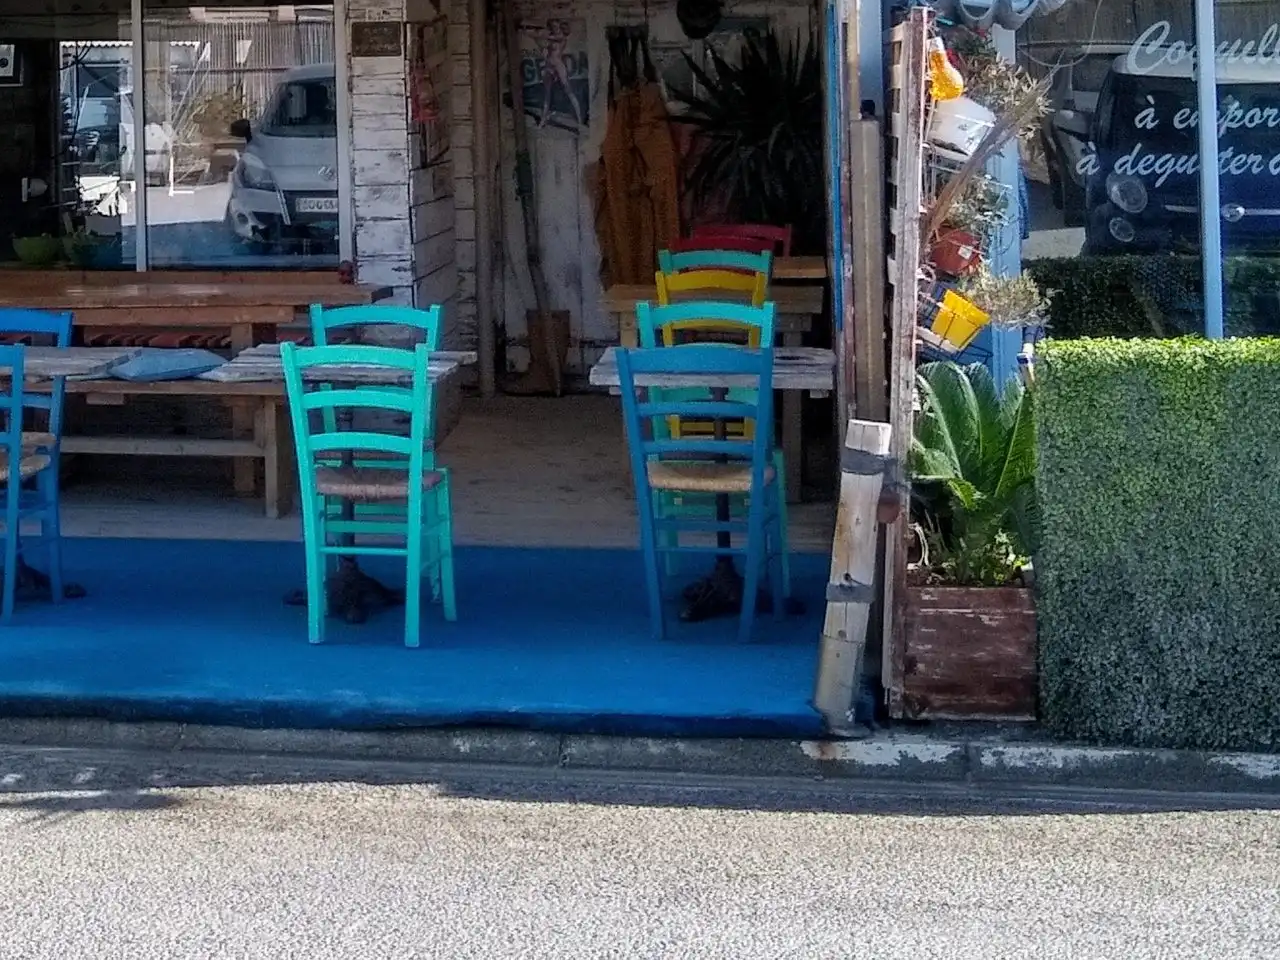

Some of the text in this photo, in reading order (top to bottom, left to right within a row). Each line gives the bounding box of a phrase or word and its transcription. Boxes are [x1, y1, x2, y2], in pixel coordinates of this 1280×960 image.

[1134, 95, 1160, 130] à
[1077, 141, 1101, 176] à
[1114, 142, 1264, 188] deguter
